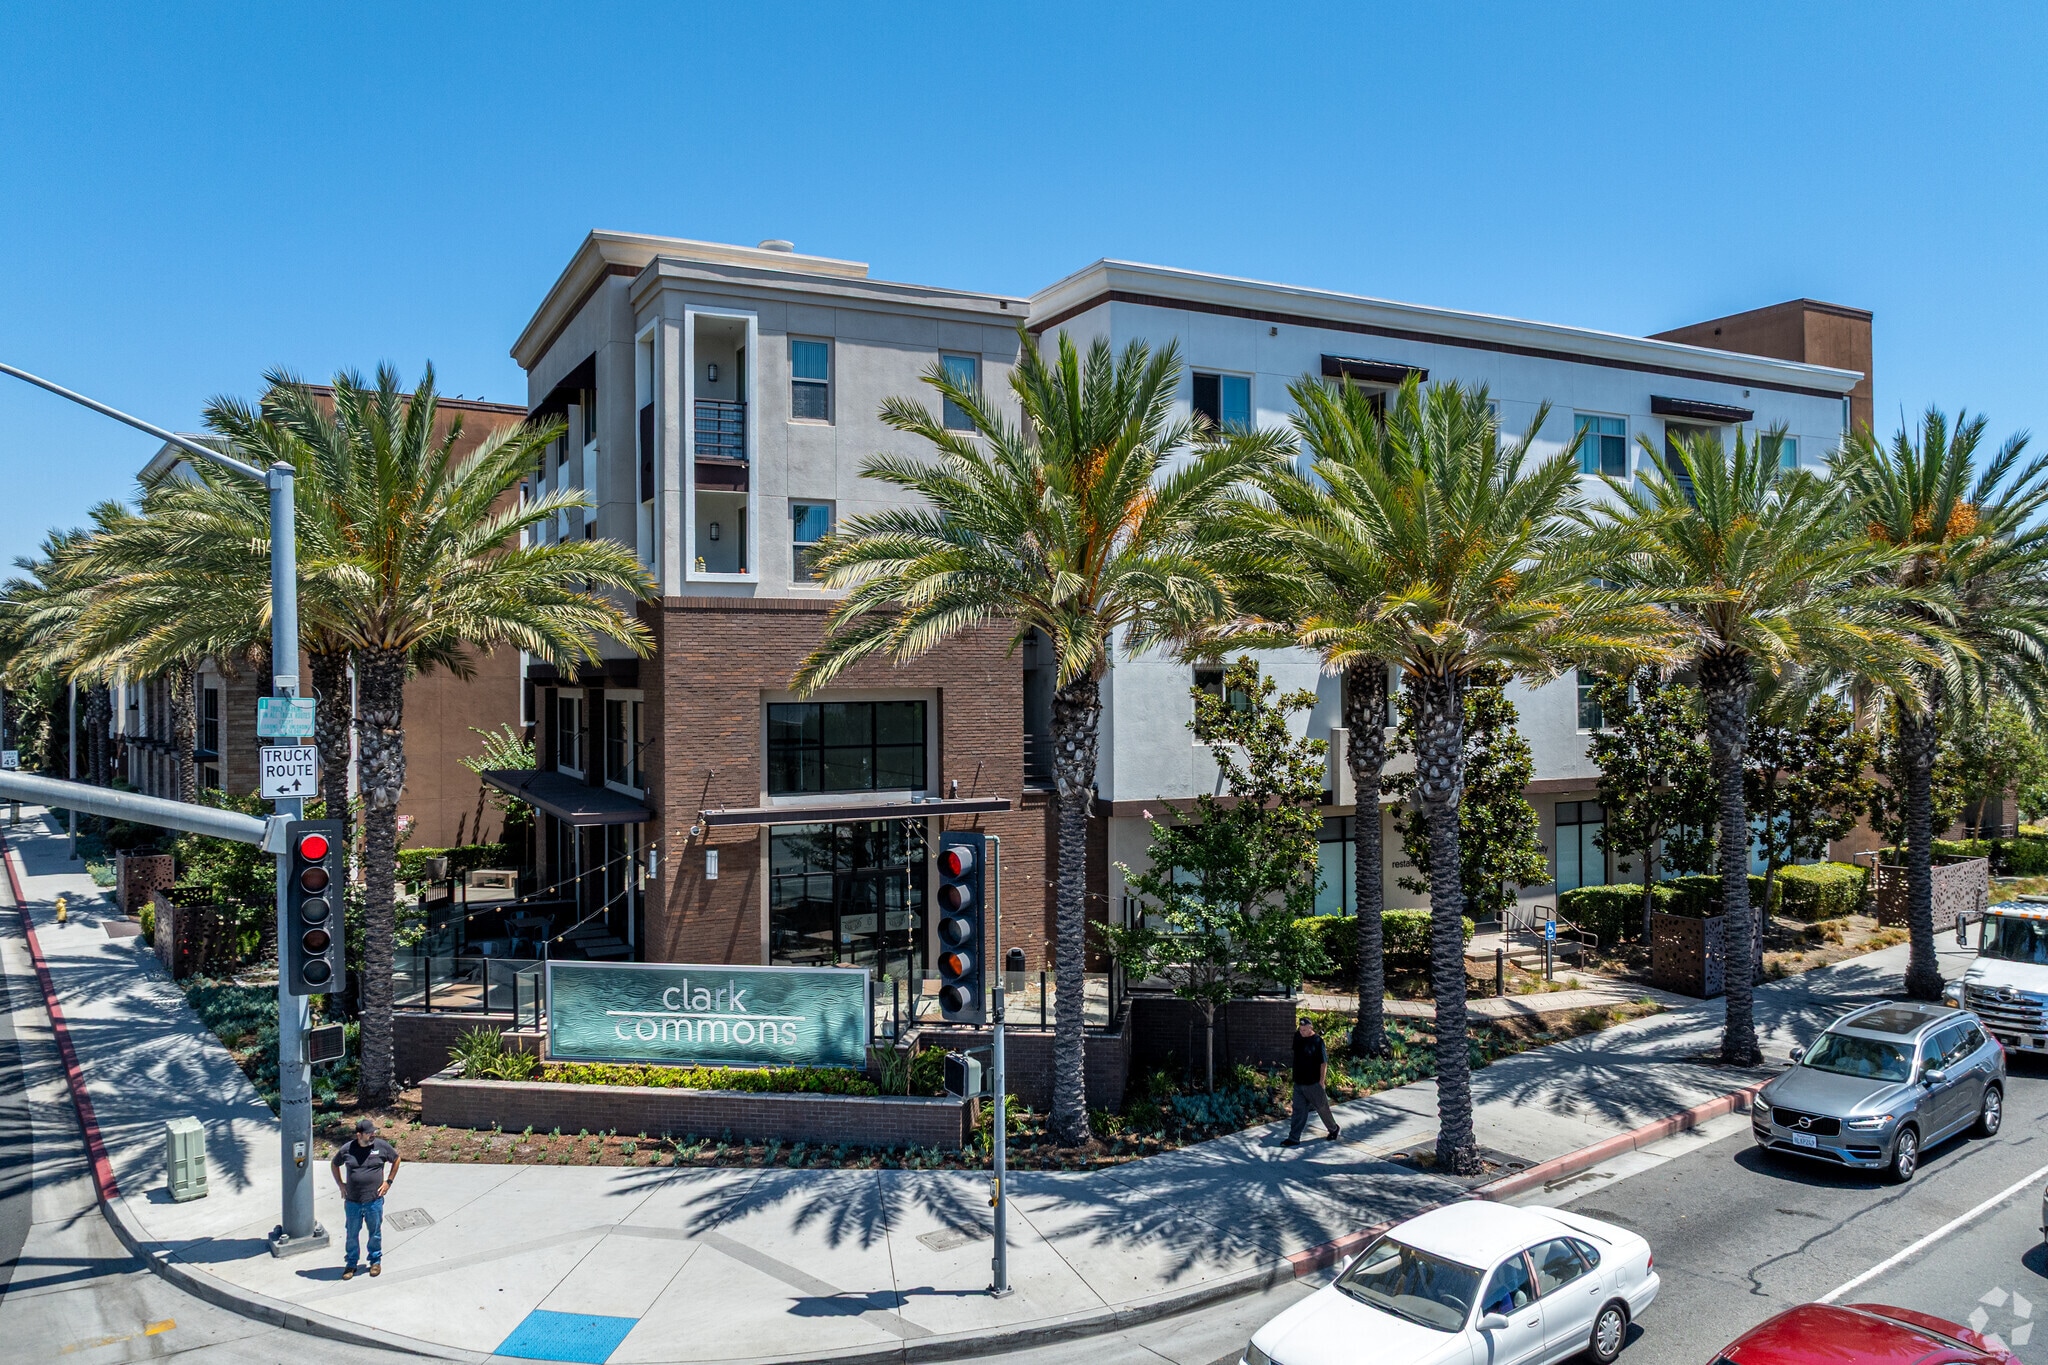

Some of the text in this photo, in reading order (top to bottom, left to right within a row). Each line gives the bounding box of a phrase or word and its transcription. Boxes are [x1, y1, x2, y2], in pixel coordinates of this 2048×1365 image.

[264, 749, 312, 762] TRUCK
[266, 765, 313, 778] ROUTE
[662, 978, 747, 1012] clark
[615, 1016, 797, 1046] commons
